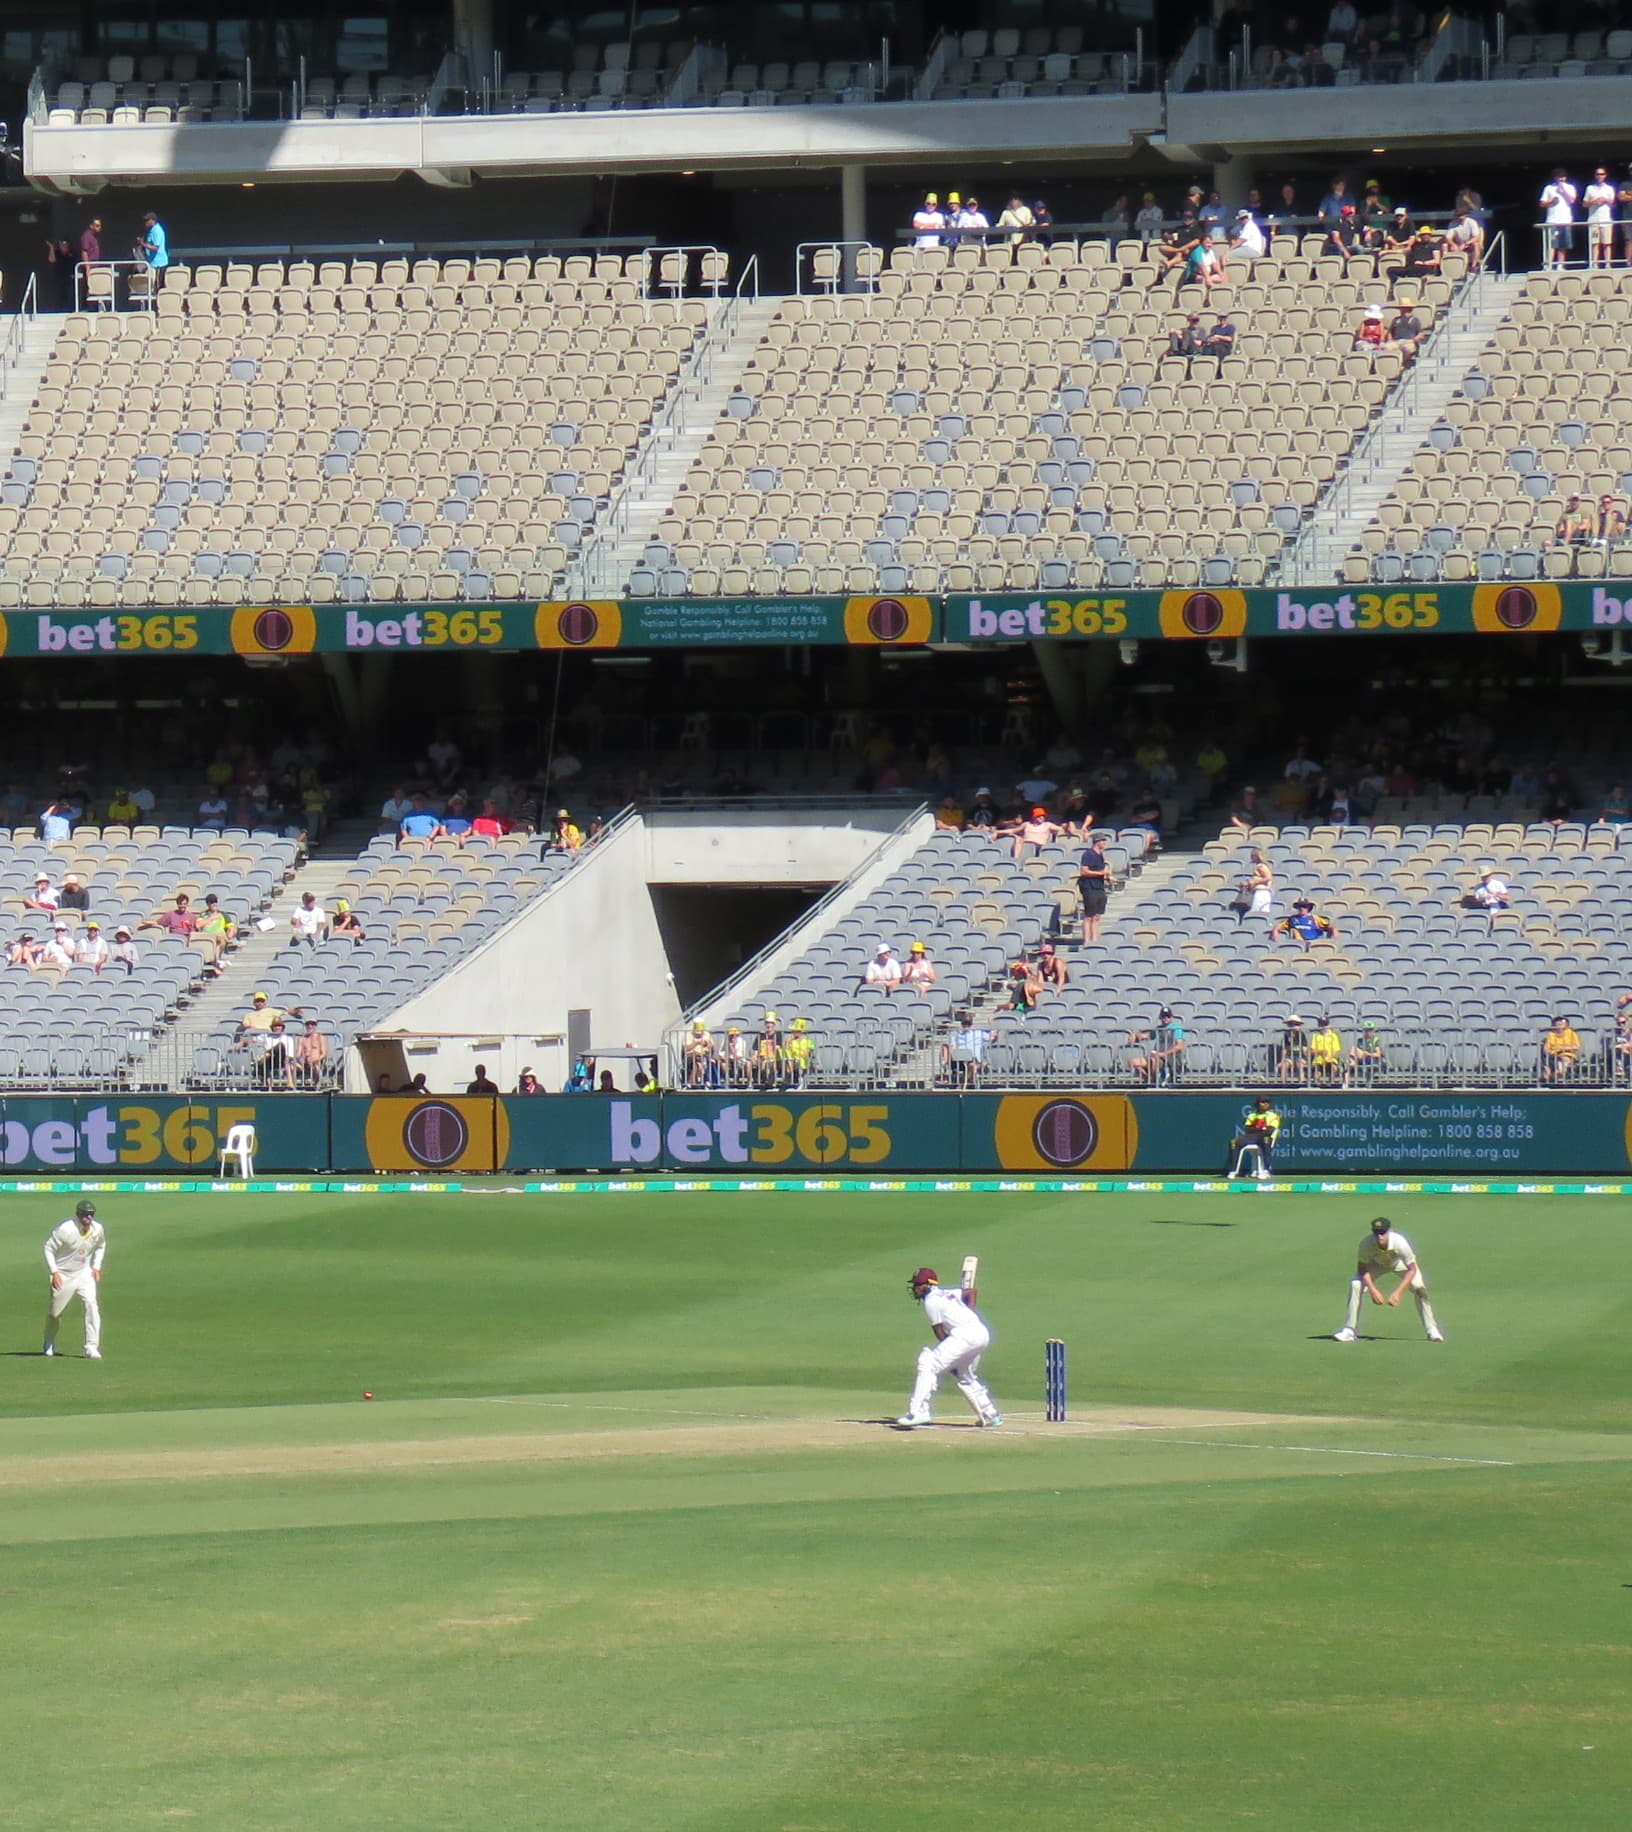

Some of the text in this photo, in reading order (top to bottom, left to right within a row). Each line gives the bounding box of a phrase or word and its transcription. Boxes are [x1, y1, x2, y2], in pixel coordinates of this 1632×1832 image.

[345, 610, 504, 646] bet365
[968, 599, 1127, 637] bet365
[1277, 593, 1439, 631] bet365
[38, 615, 199, 651] bet365
[1241, 1104, 1297, 1119] Gble
[1301, 1104, 1382, 1122] Responsibly.
[1388, 1104, 1415, 1119] Call
[1419, 1104, 1487, 1119] Gambler's
[610, 1101, 892, 1165] bet365
[1299, 1124, 1368, 1141] Gambling
[1372, 1124, 1433, 1140] Helpline:
[1438, 1124, 1471, 1139] 1800
[1476, 1124, 1502, 1139] 858
[1507, 1124, 1534, 1139] 858
